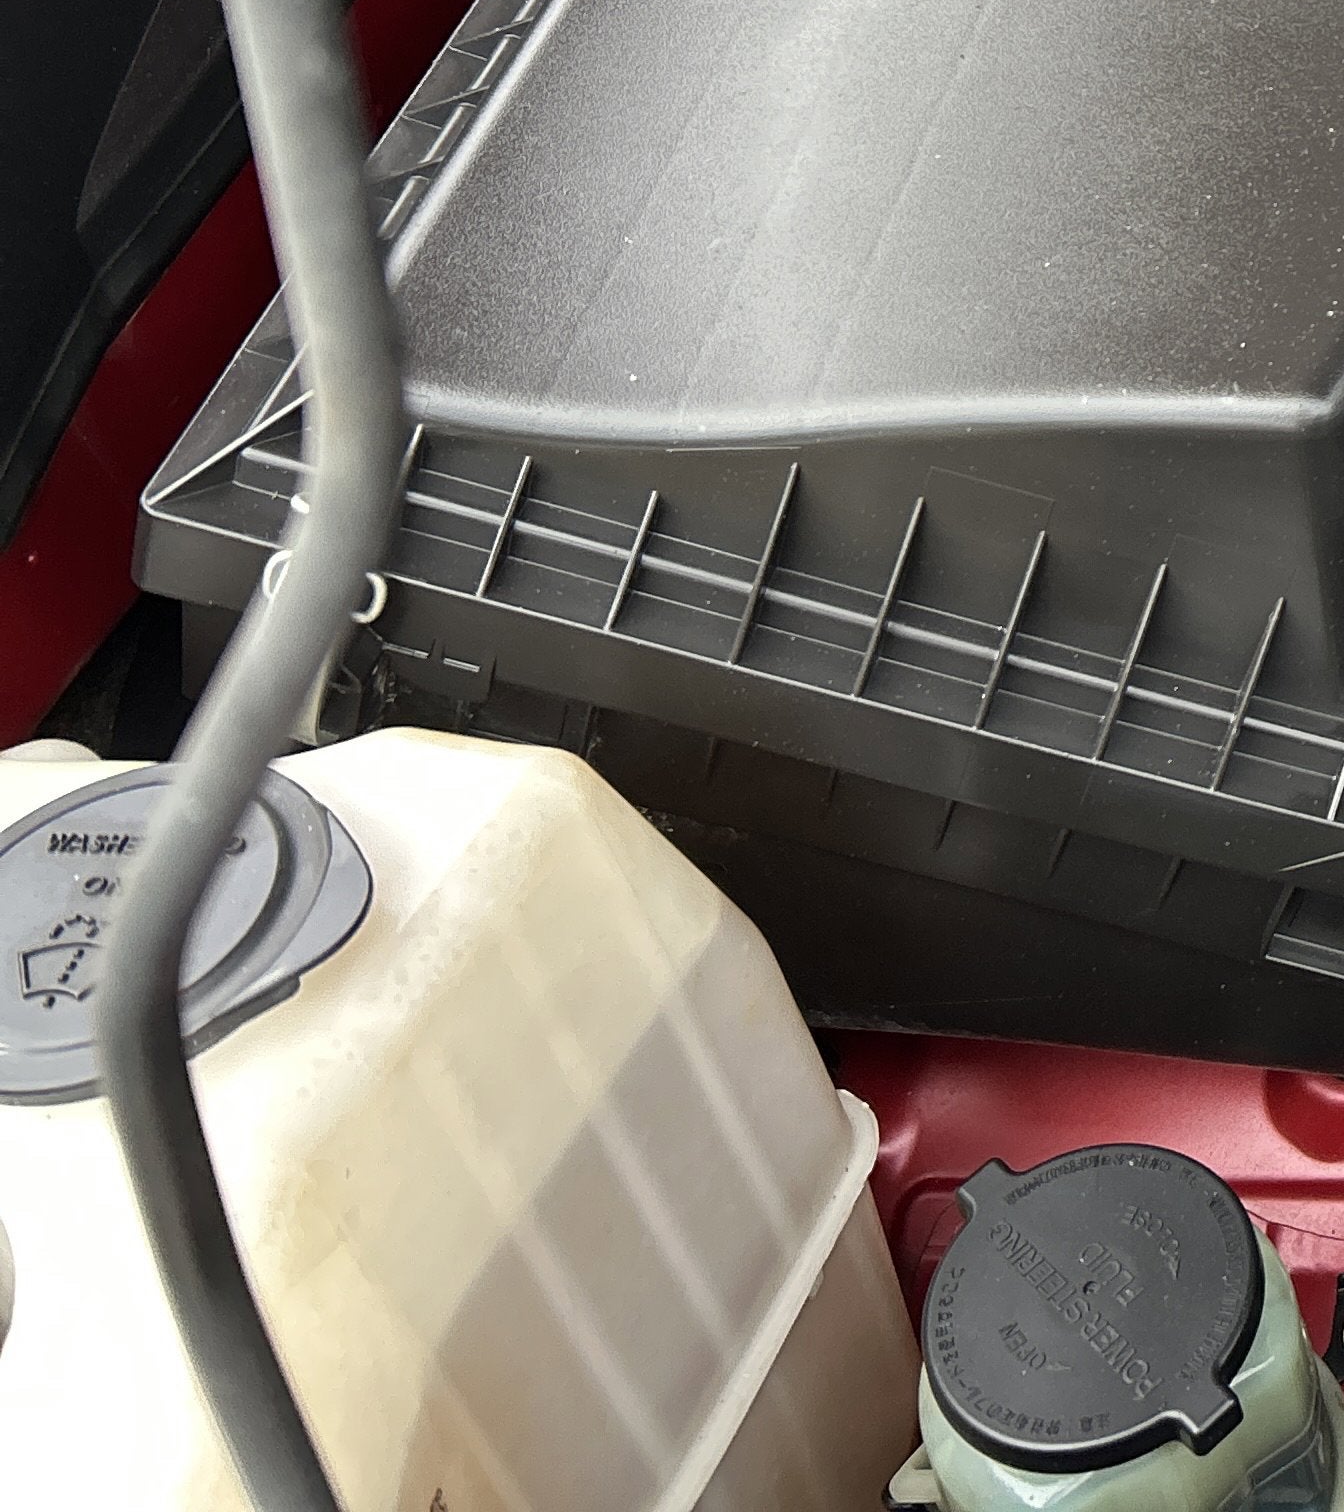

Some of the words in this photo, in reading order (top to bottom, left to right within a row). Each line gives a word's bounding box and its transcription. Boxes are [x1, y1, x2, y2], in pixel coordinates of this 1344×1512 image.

[1119, 1202, 1180, 1257] CLOSE
[987, 1220, 1091, 1326] STEERING
[1078, 1241, 1143, 1307] FLUID
[998, 1321, 1046, 1372] OPEN
[1080, 1313, 1163, 1402] POWER
